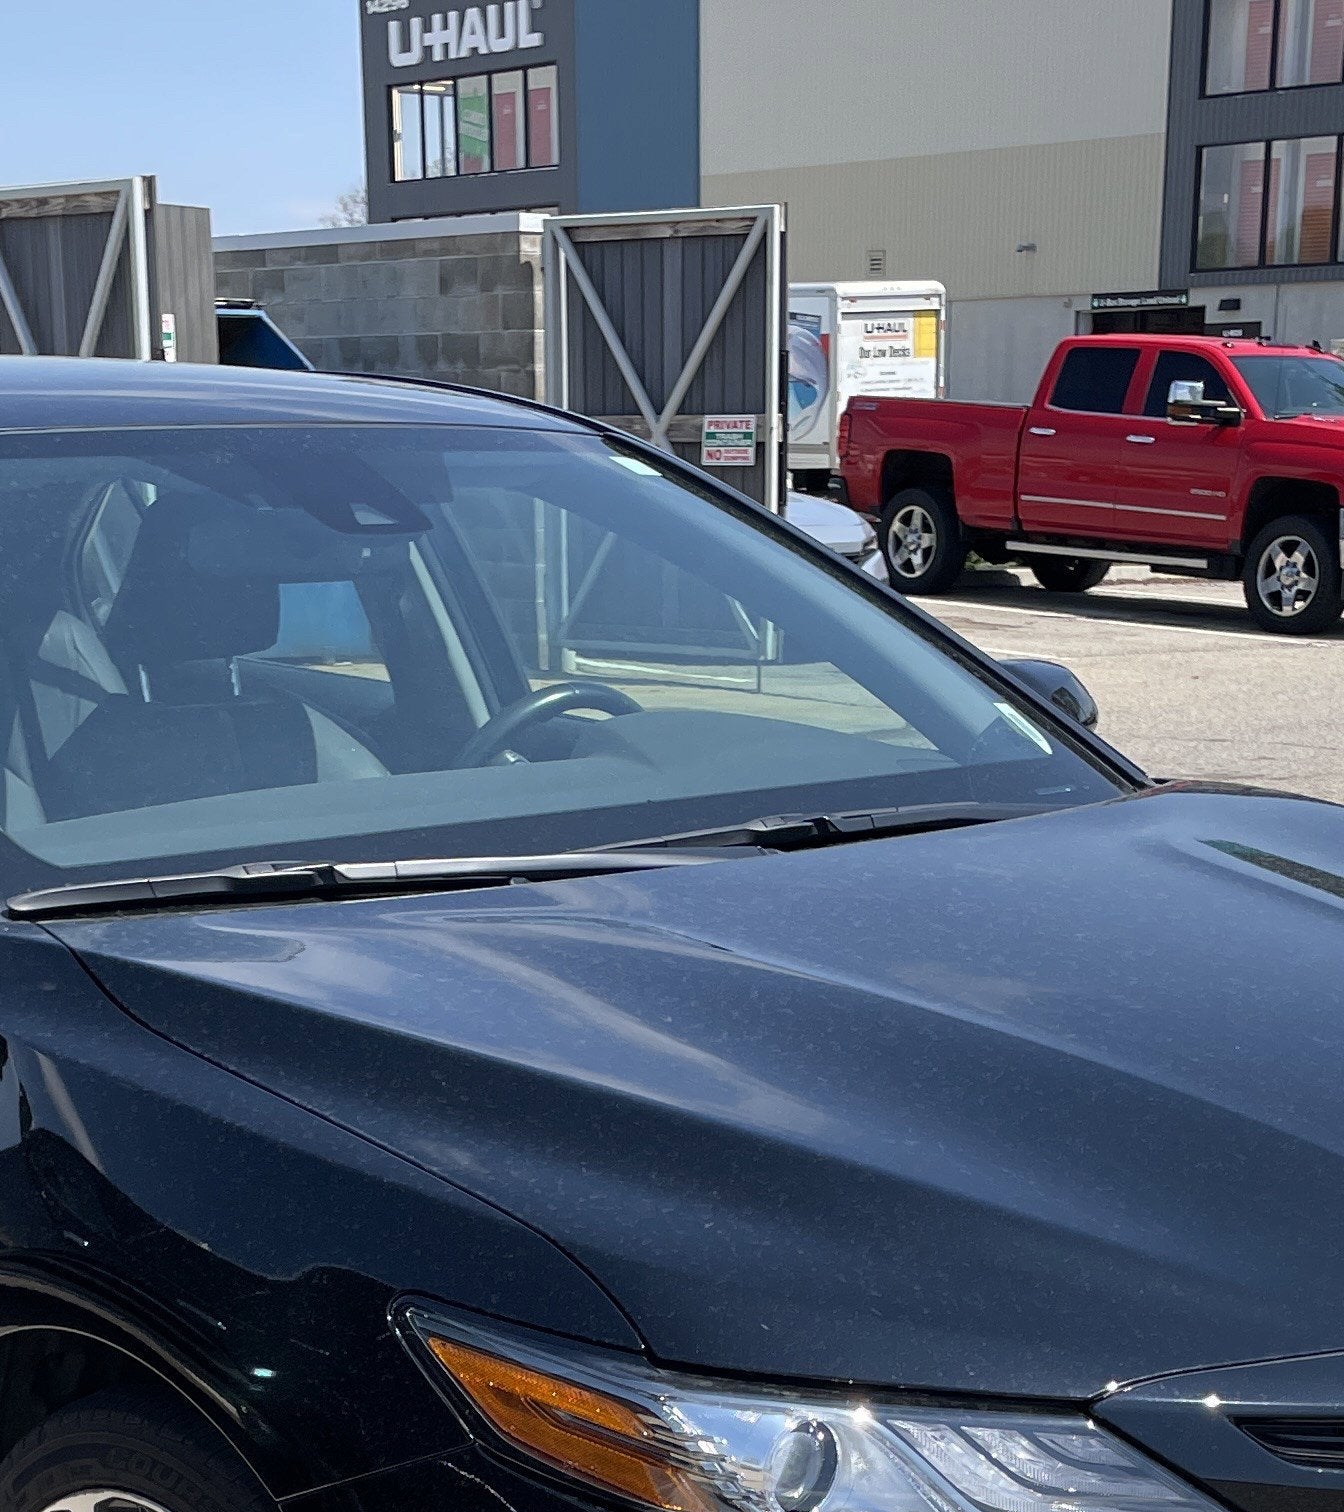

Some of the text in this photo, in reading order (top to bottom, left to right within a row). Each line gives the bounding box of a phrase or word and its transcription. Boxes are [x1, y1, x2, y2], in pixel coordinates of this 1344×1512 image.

[387, 0, 544, 67] U-HAUL
[864, 322, 908, 334] U-HAUL
[707, 420, 752, 430] PRIVATE
[706, 449, 722, 461] NO
